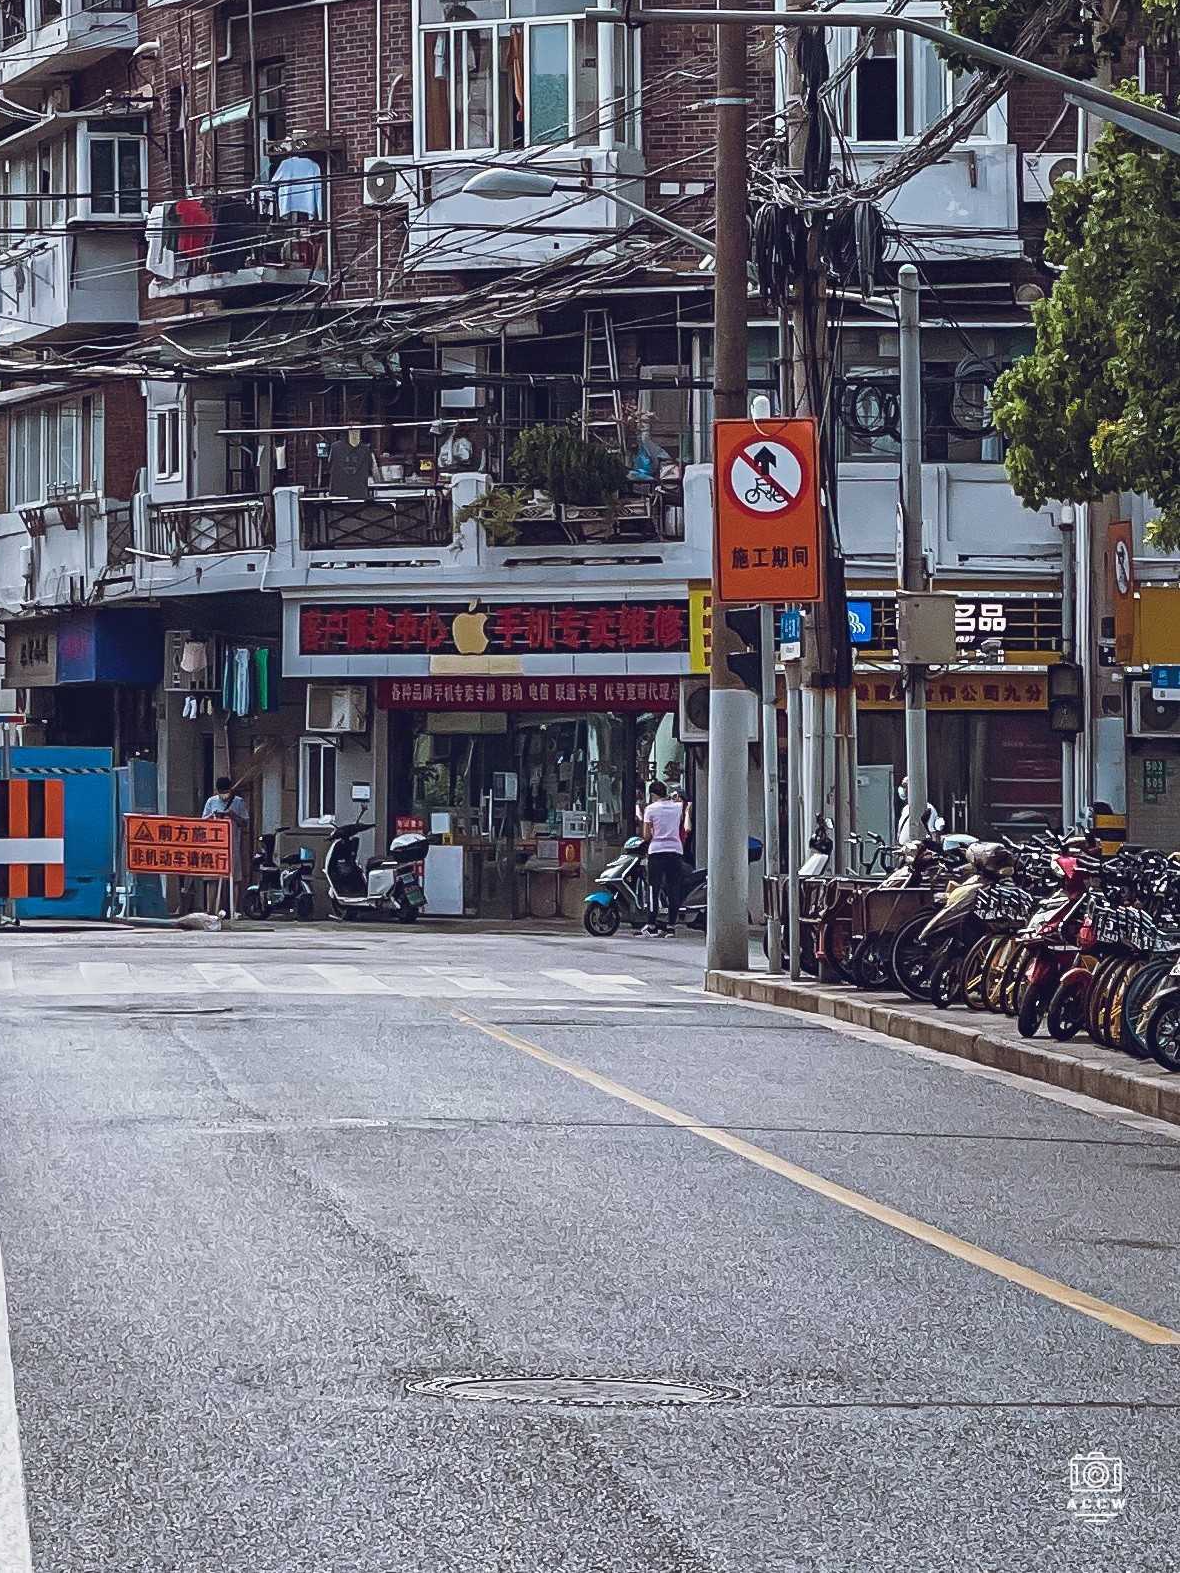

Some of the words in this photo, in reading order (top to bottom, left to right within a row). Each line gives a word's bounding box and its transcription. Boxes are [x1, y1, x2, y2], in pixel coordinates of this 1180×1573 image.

[731, 545, 809, 569] 施工期间
[494, 604, 683, 649] 手机专卖维修
[157, 823, 225, 843] 前方施工
[131, 848, 228, 870] 非机动车请绕行
